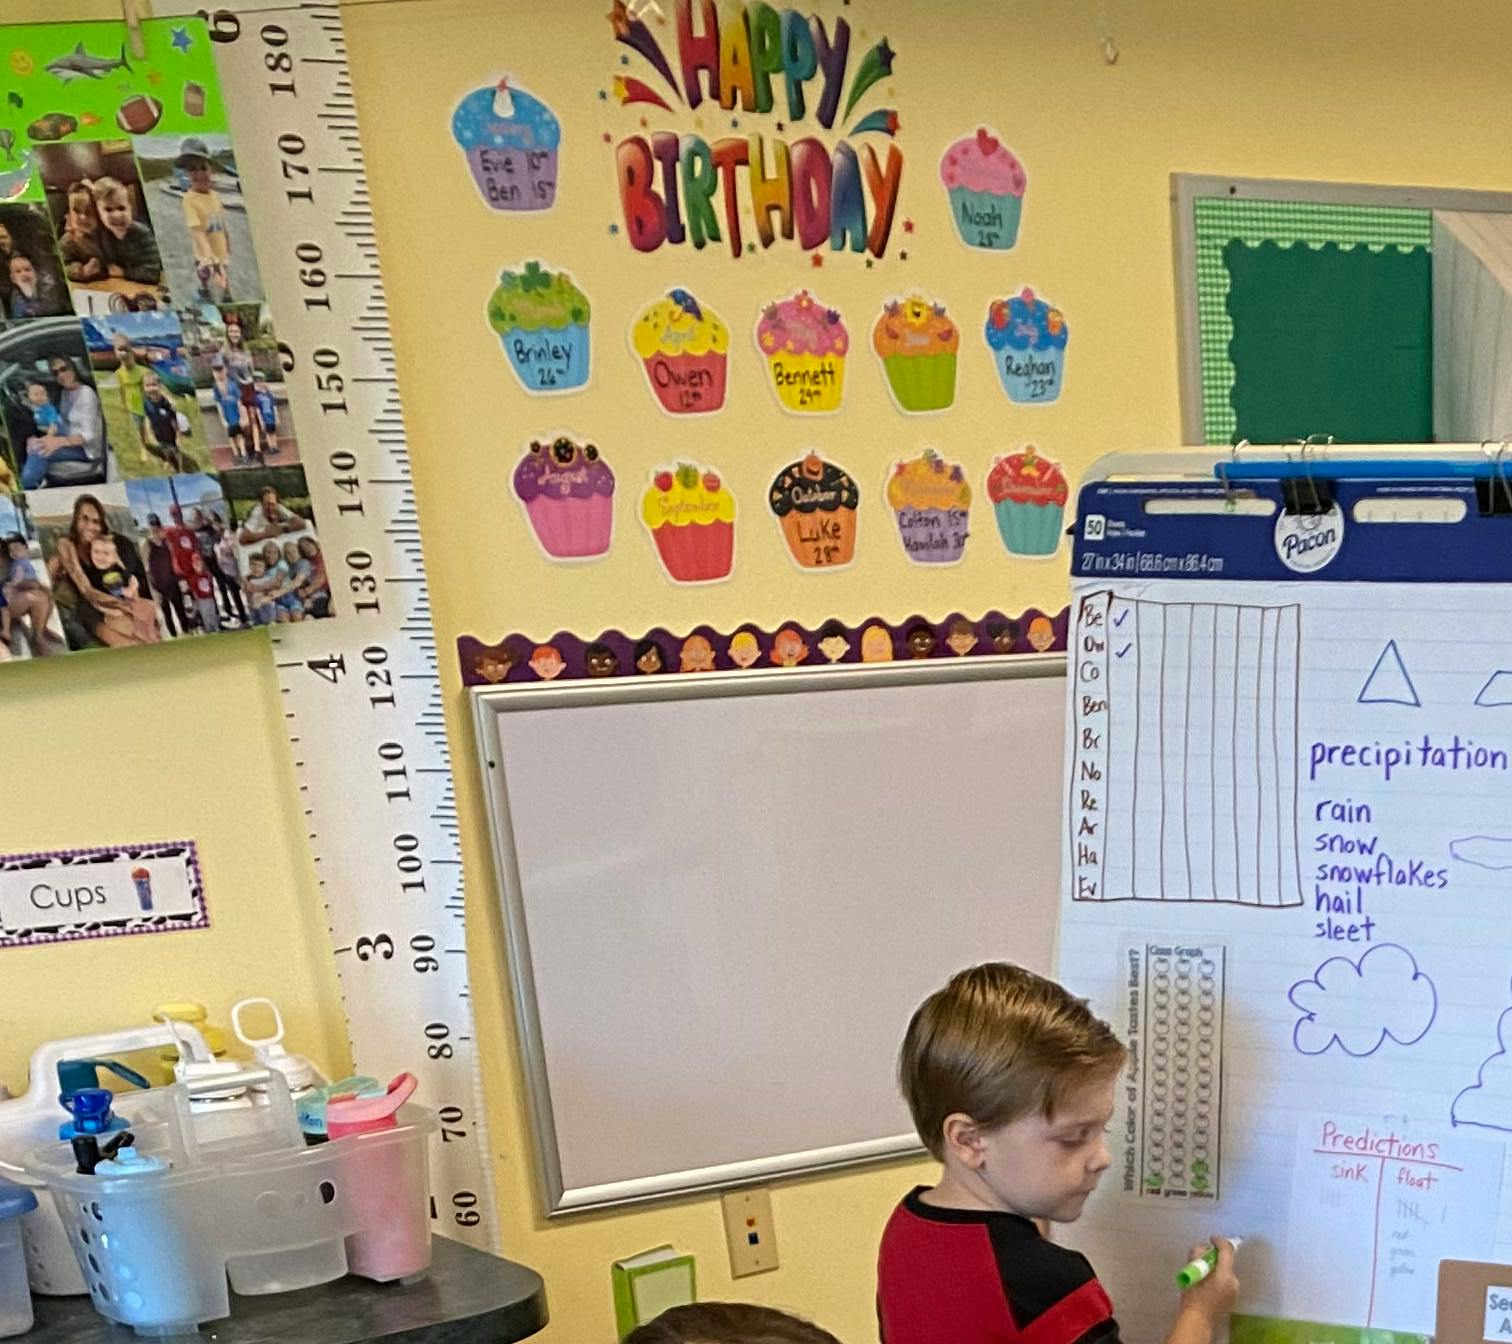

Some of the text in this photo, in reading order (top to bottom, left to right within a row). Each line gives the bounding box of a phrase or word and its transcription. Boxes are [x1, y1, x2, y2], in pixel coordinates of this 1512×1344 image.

[260, 24, 298, 99] 180
[675, 0, 850, 130] HAPPY
[277, 133, 315, 205] 170
[486, 177, 521, 202] Ben
[616, 131, 904, 259] BIRTHDAY
[961, 201, 1004, 230] Noah
[295, 242, 331, 313] 160
[512, 338, 573, 371] Brinley
[313, 348, 349, 417] 150
[654, 360, 714, 389] Owen
[773, 363, 835, 386] Bennett
[329, 450, 364, 518] 140
[1086, 520, 1103, 536] 50
[1282, 528, 1336, 559] Pacon
[345, 550, 381, 618] 130
[307, 651, 347, 685] 4
[362, 643, 396, 710] 120
[1080, 660, 1100, 683] Co
[1082, 695, 1109, 716] Ben
[1082, 727, 1101, 750] Br
[377, 741, 411, 804] 110
[1080, 760, 1102, 781] No
[1310, 734, 1509, 781] precipitation
[1078, 815, 1099, 836] Ar
[1315, 798, 1372, 824] rain
[1077, 842, 1098, 867] Ha
[1314, 833, 1379, 856] snow
[393, 833, 427, 895] 100
[29, 881, 108, 912] Cups
[1315, 883, 1363, 915] hail
[1314, 915, 1377, 942] sleet
[355, 931, 395, 962] 3
[412, 933, 440, 975] 90
[1128, 948, 1140, 988] Best?
[1127, 990, 1139, 1036] Tastes
[424, 1021, 454, 1062] 80
[1125, 1087, 1137, 1103] of
[439, 1106, 466, 1142] 70
[1124, 1106, 1137, 1145] Color
[1321, 1120, 1439, 1160] Predictions
[1123, 1147, 1136, 1193] Which
[1396, 1166, 1439, 1191] float
[452, 1190, 480, 1227] 60
